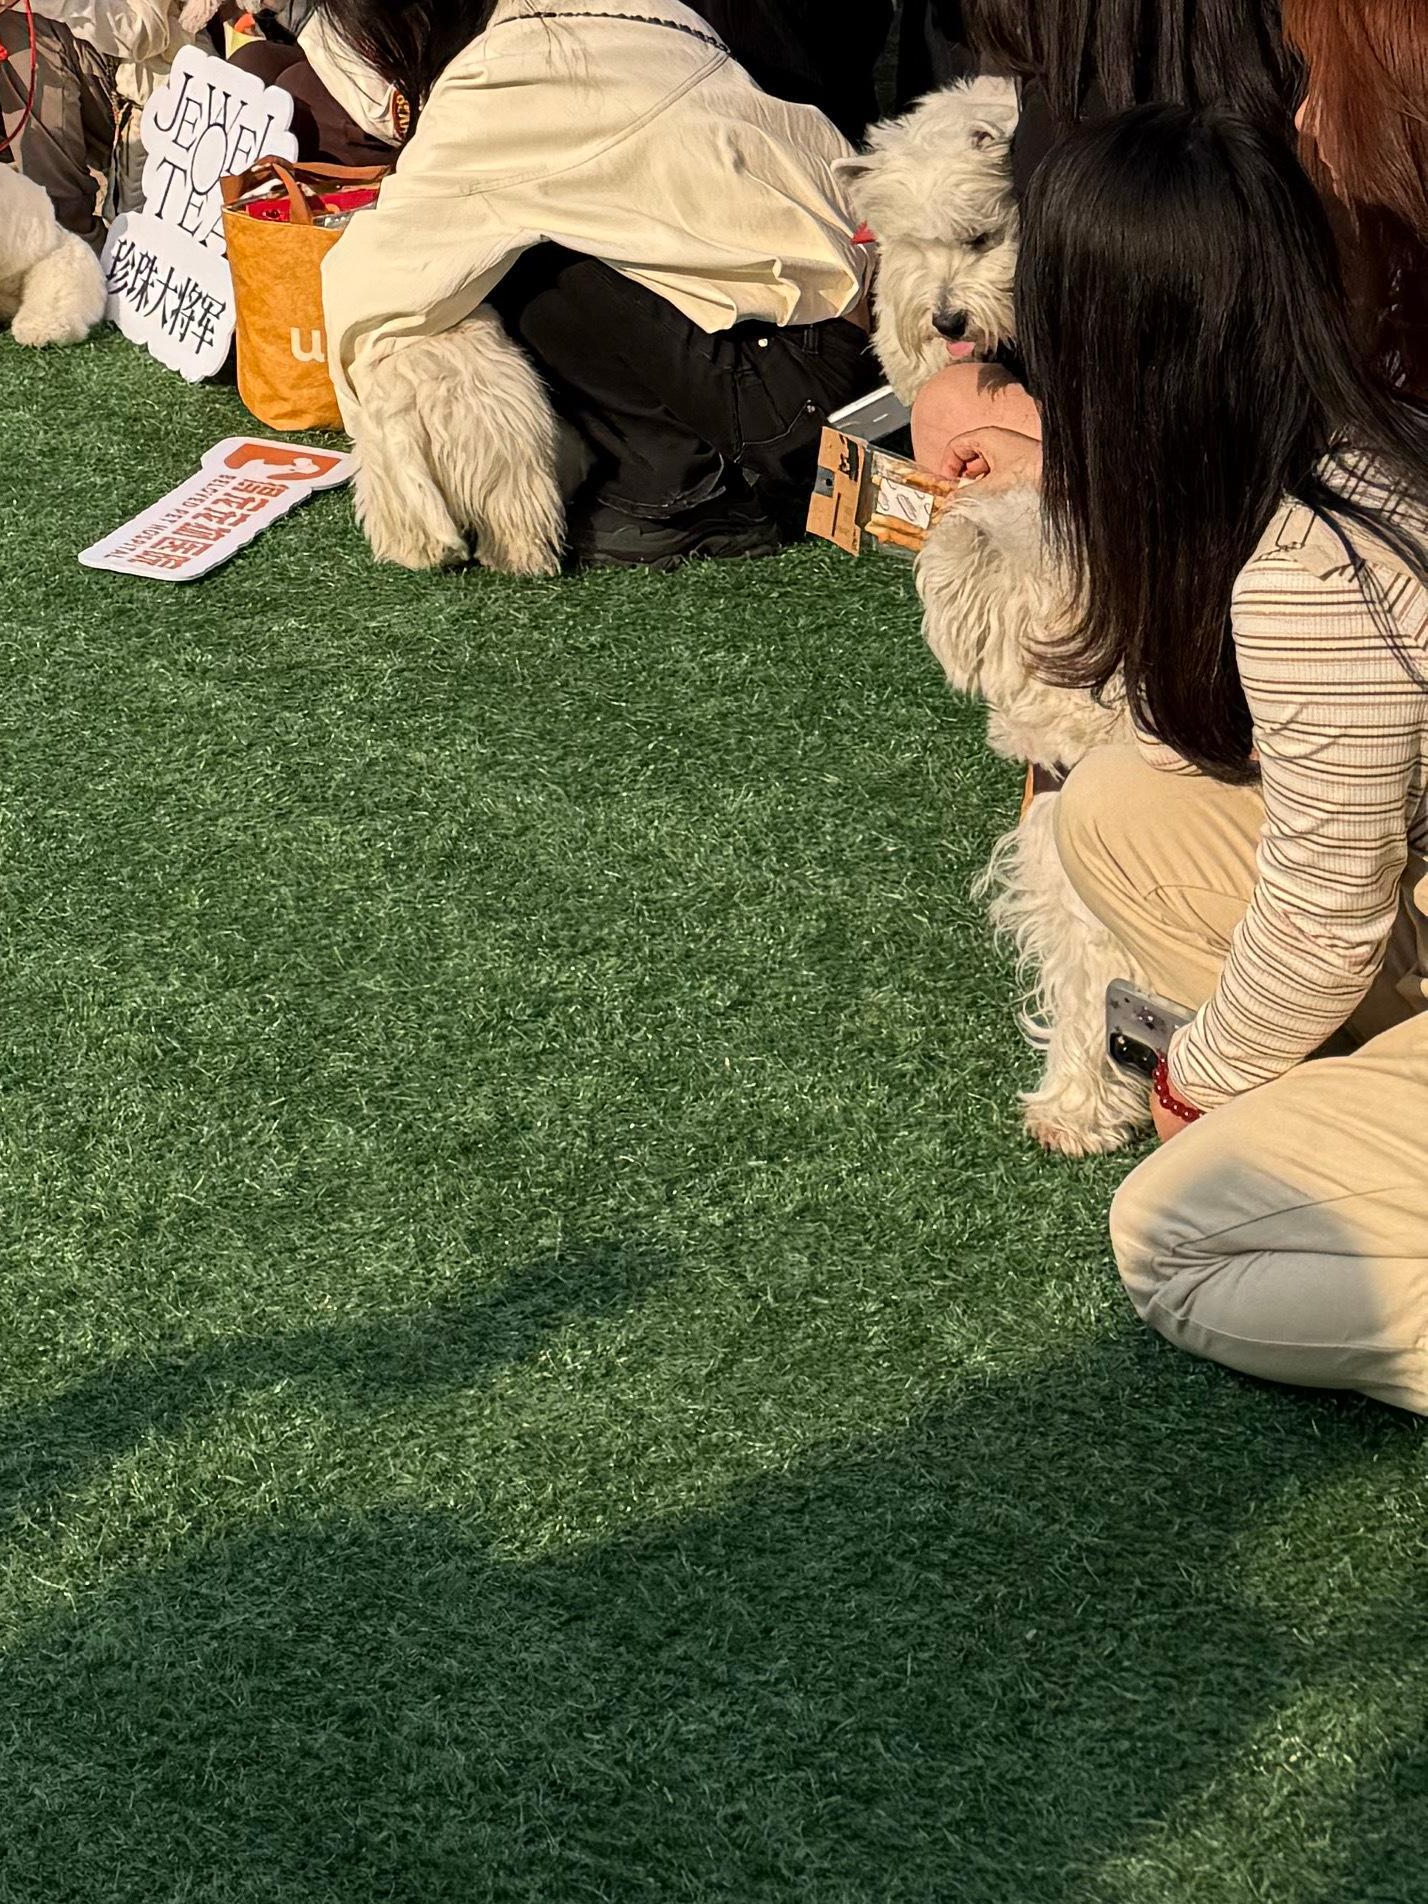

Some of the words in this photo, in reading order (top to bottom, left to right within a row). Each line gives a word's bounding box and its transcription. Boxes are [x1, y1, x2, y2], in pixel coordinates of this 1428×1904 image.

[105, 238, 227, 355] 珍珠大将军
[159, 507, 189, 524] PET
[104, 522, 168, 559] HOSPITAL
